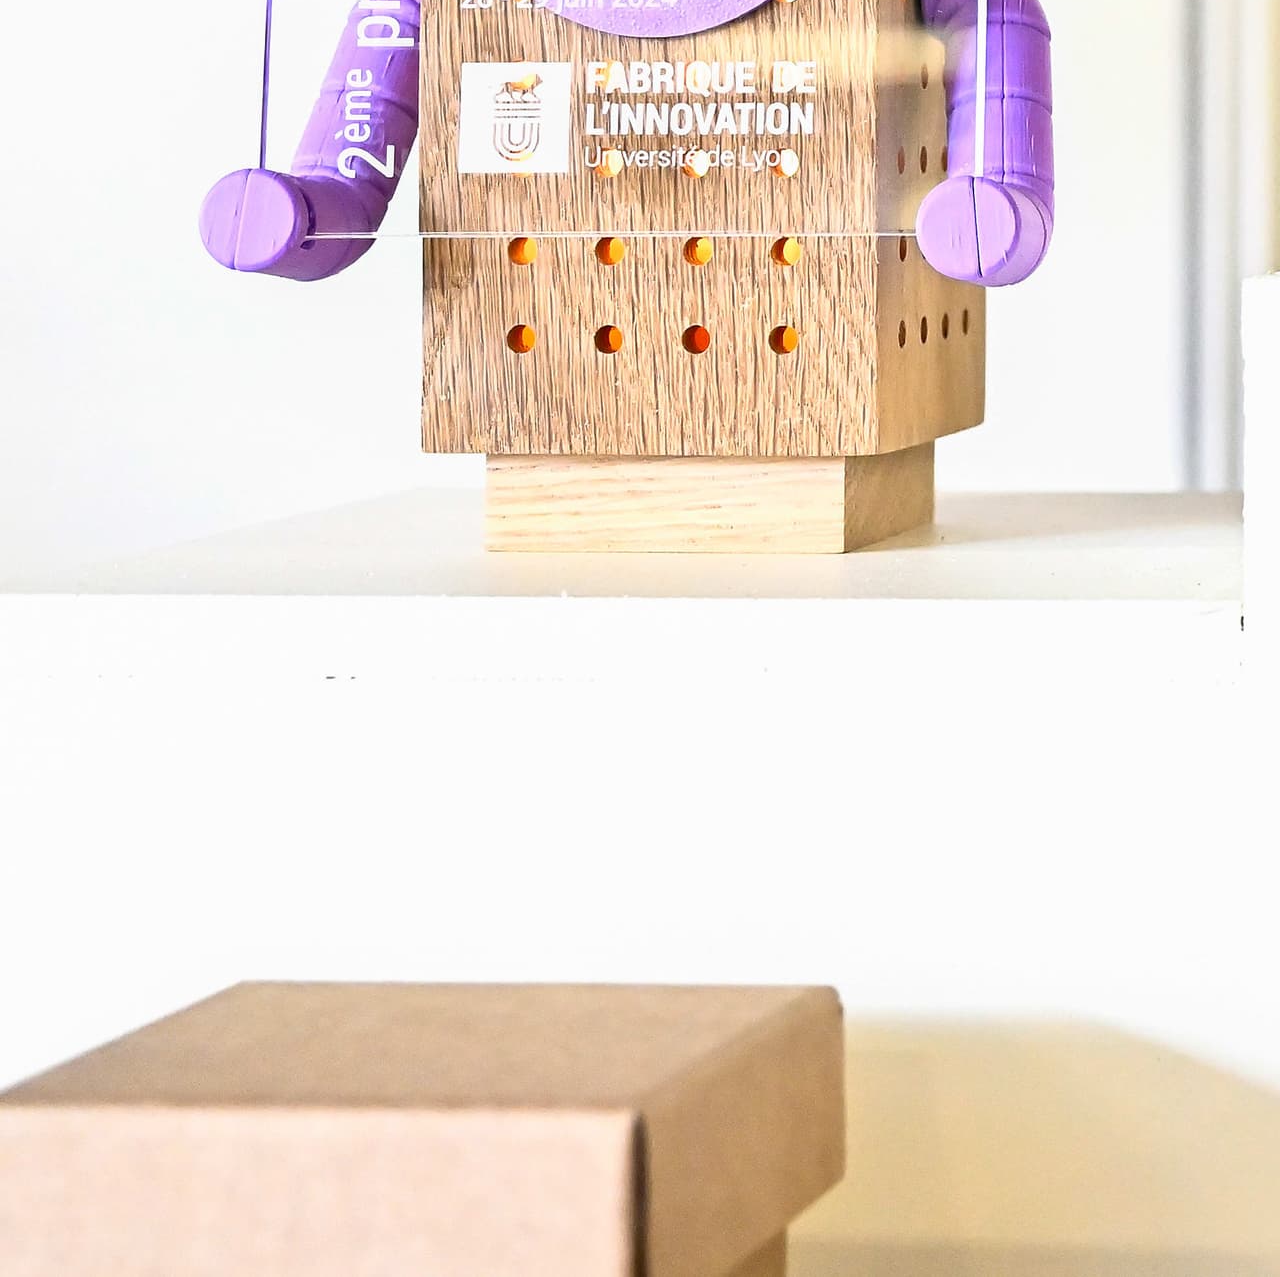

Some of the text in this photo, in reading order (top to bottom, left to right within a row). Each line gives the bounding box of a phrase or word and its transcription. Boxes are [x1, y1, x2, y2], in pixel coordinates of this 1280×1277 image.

[585, 60, 817, 97] FABRIQUE DE
[334, 68, 396, 179] 2ème
[585, 102, 815, 137] L'INNOVATION
[707, 143, 735, 168] de
